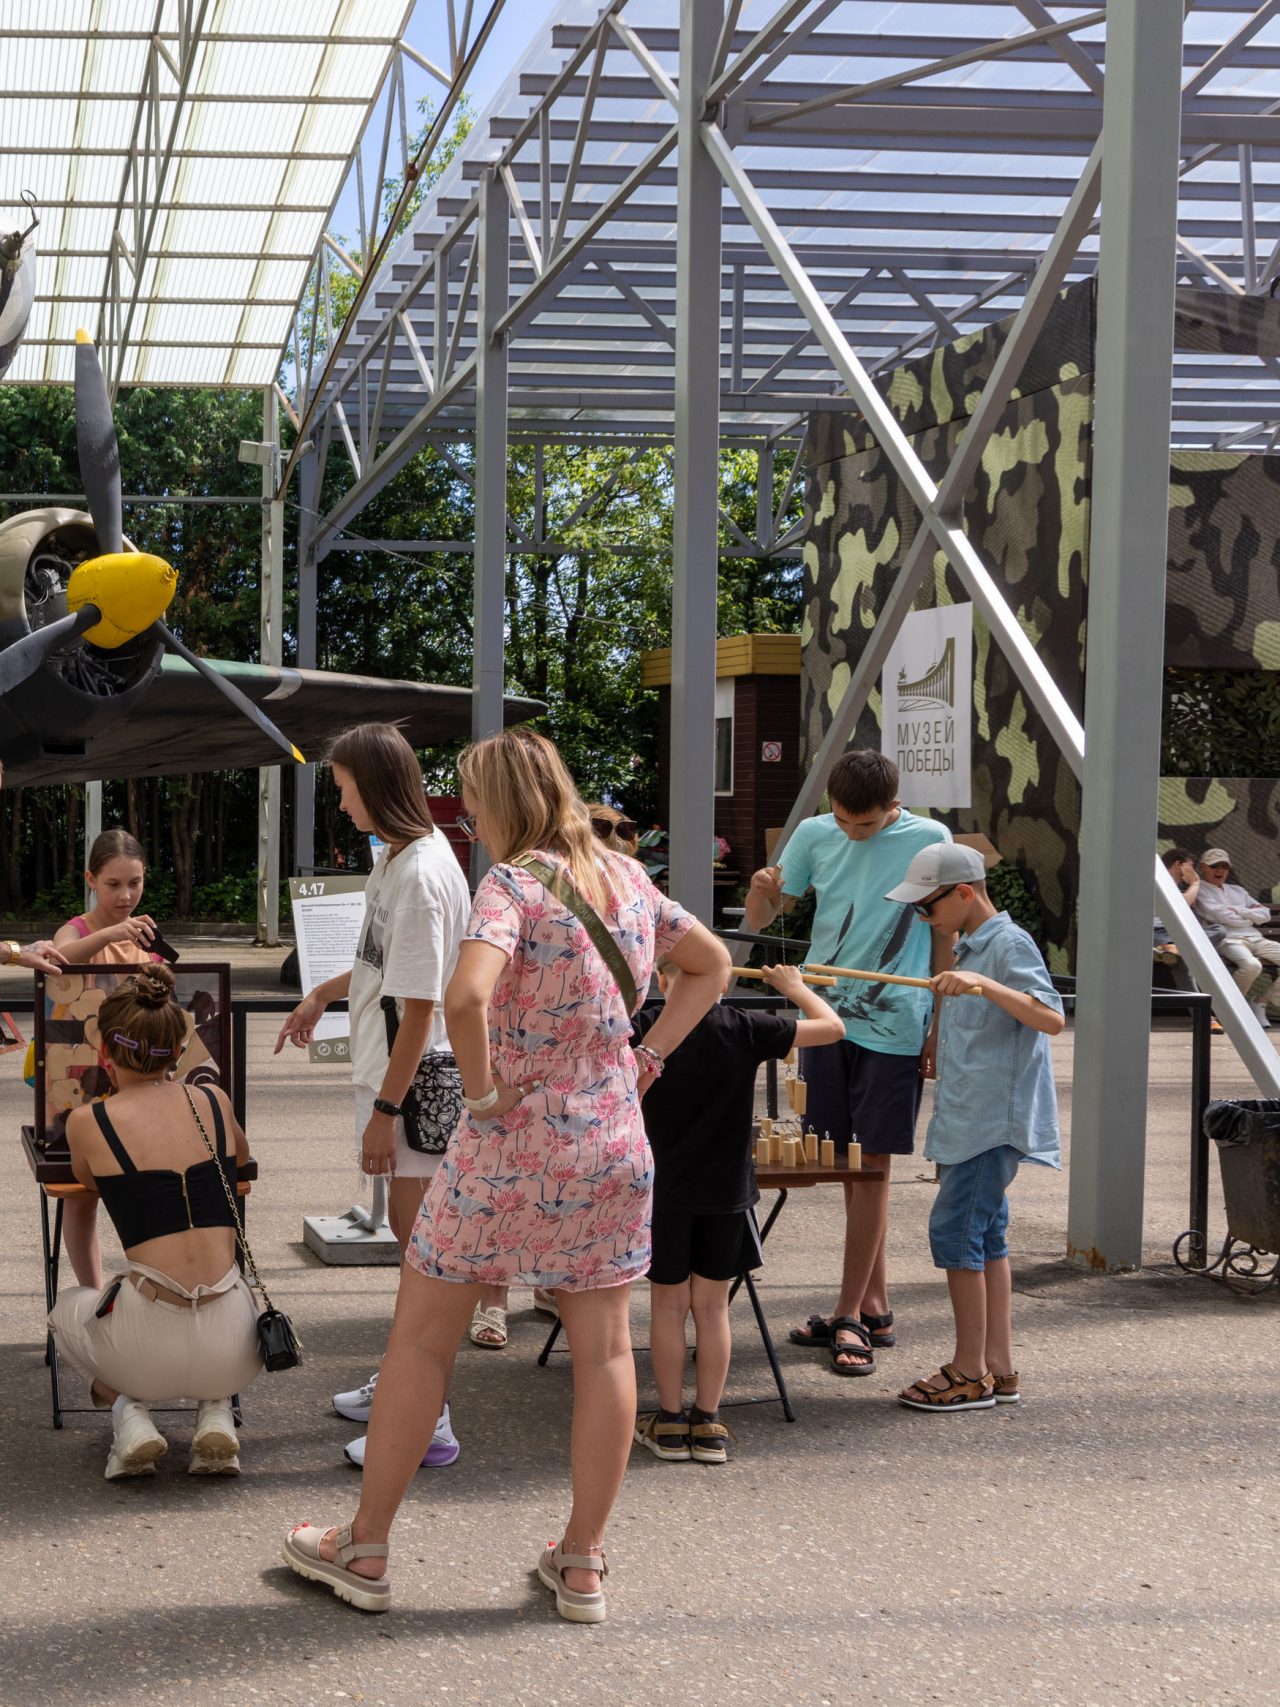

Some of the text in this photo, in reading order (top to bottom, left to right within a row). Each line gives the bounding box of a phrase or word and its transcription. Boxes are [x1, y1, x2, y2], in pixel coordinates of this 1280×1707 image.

[896, 716, 955, 746] МУЗЕЙ
[896, 748, 955, 777] ПОБЕДЫ
[298, 882, 325, 896] 4.17
